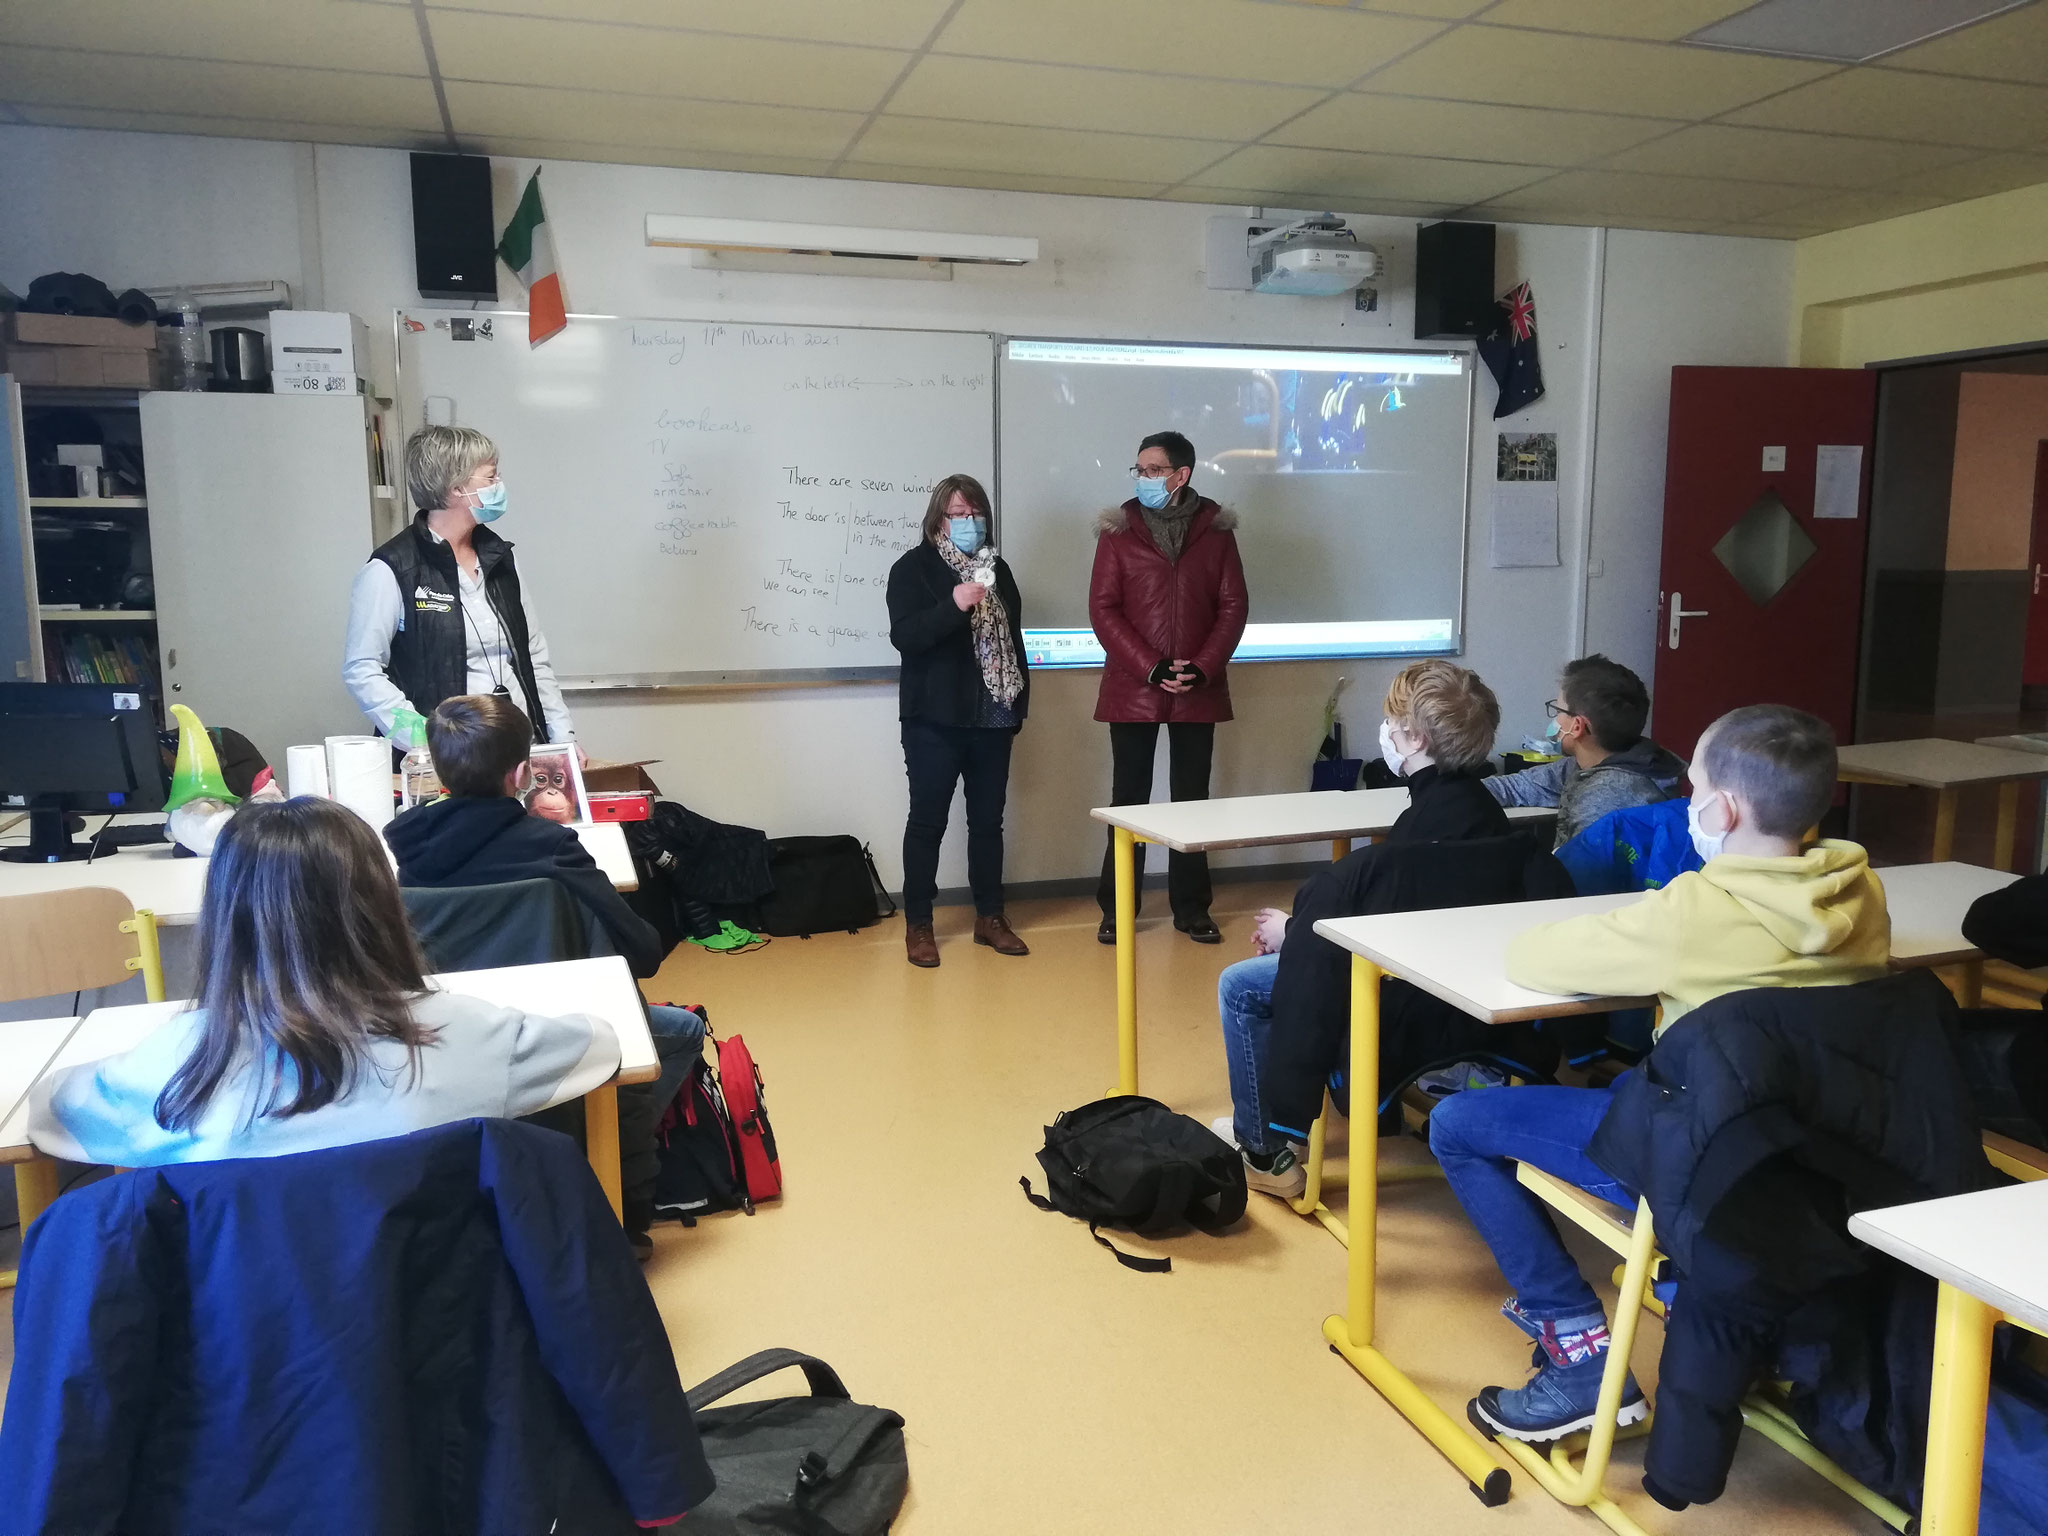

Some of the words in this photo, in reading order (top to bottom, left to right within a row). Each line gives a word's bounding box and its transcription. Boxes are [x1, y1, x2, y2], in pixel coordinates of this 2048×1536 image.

[742, 330, 795, 347] March
[303, 378, 319, 390] 80
[804, 376, 820, 390] the
[941, 373, 956, 387] the
[962, 374, 984, 390] right
[647, 438, 671, 455] TV
[782, 465, 822, 487] There
[829, 477, 853, 489] are
[860, 479, 895, 492] seven
[776, 500, 797, 520] The
[804, 506, 830, 523] door
[834, 511, 846, 525] is
[853, 509, 895, 529] between
[897, 511, 920, 530] two
[852, 531, 863, 544] in
[869, 532, 887, 548] the
[776, 558, 814, 583] There
[825, 568, 835, 584] is
[843, 573, 867, 586] one
[872, 573, 888, 588] ch
[763, 577, 780, 591] We
[786, 583, 808, 597] can
[812, 588, 829, 598] see
[740, 605, 784, 637] There
[788, 618, 799, 633] is
[808, 624, 822, 637] a
[827, 625, 870, 648] garage
